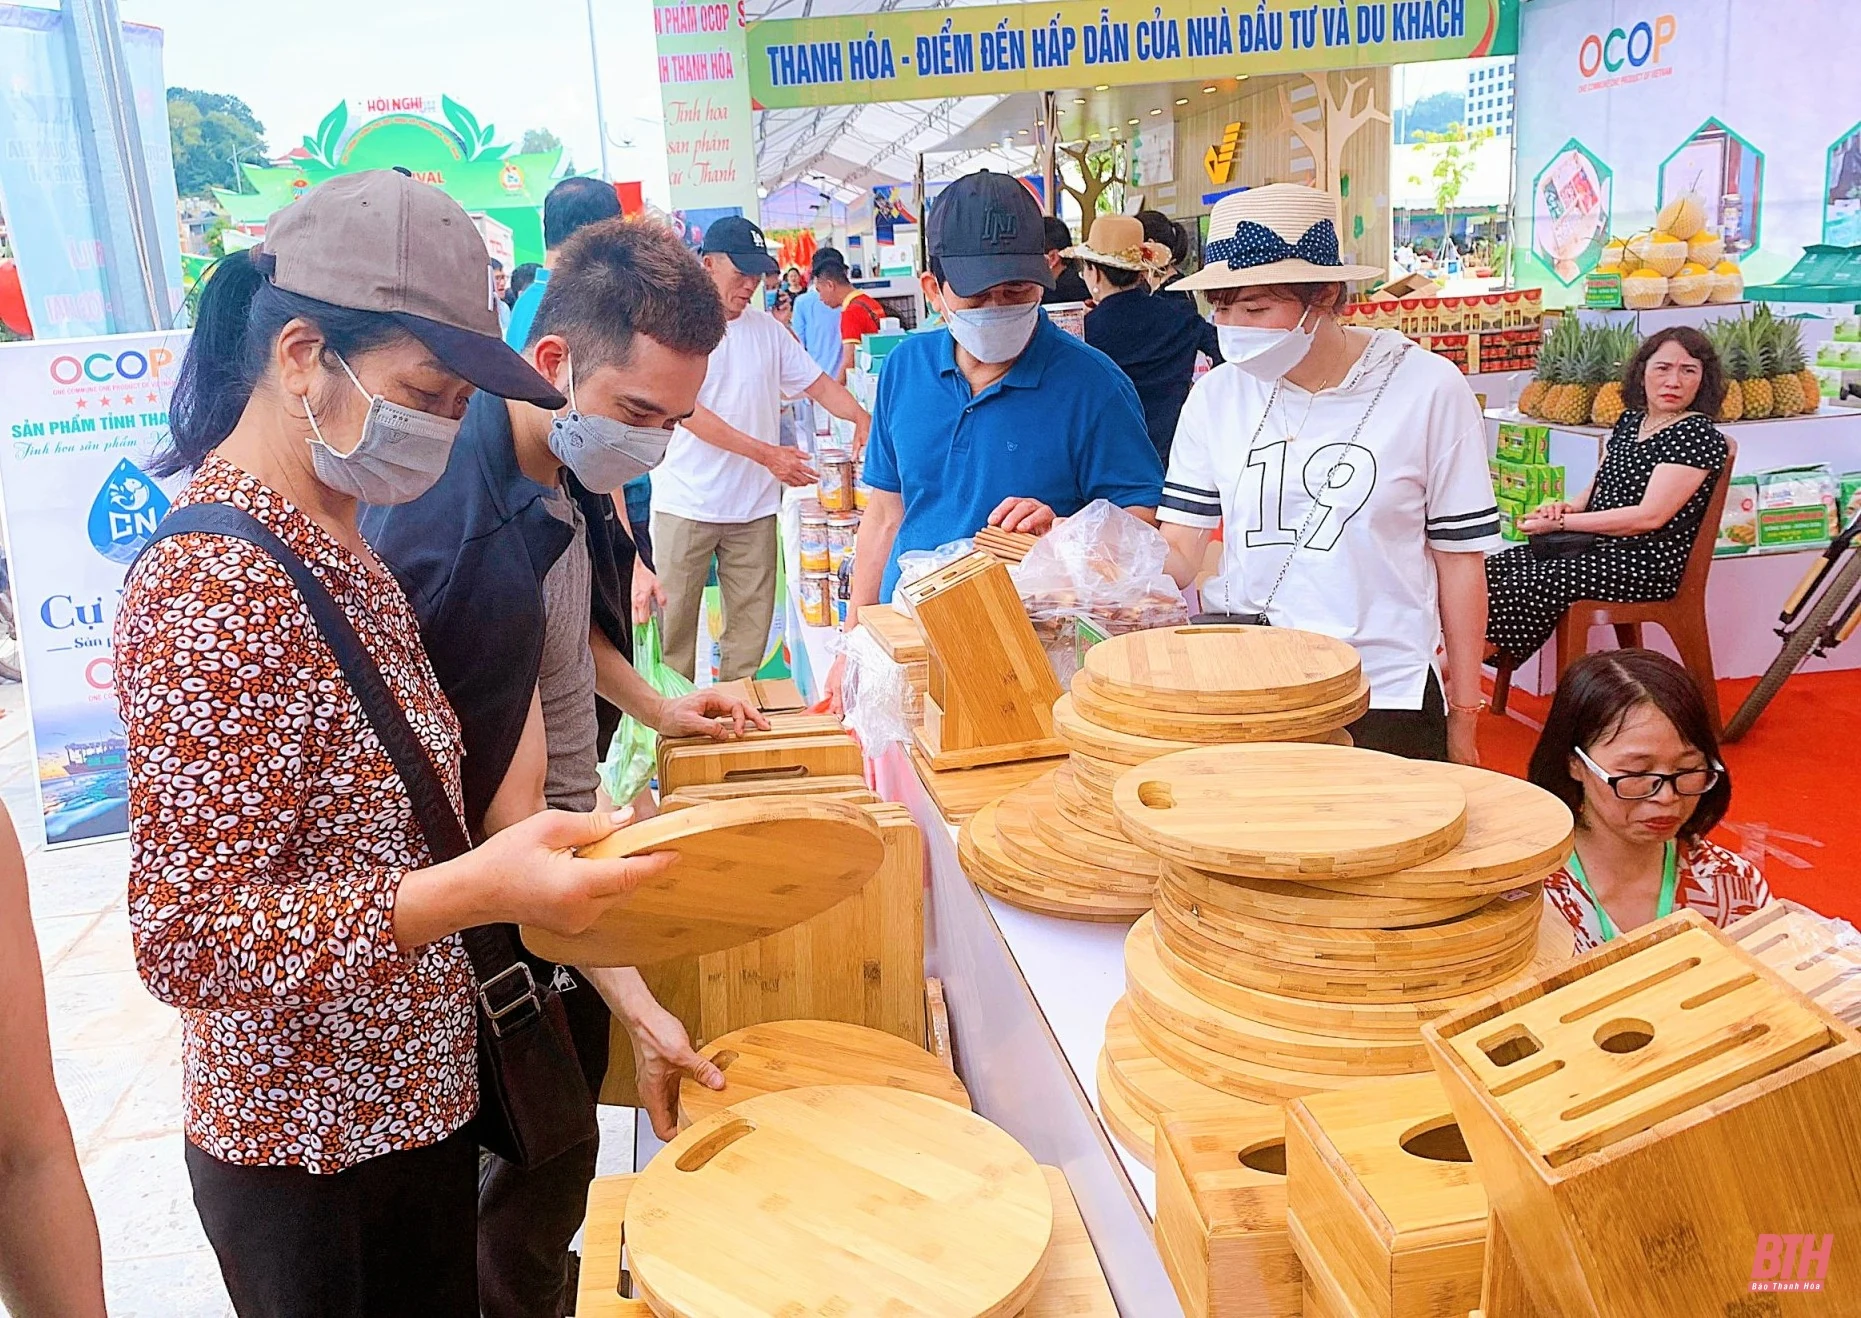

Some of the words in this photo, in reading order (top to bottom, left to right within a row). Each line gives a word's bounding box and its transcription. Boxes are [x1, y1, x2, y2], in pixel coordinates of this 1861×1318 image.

[701, 4, 729, 32] OCOP
[767, 42, 843, 86] THANH
[849, 31, 896, 81] HÓA
[916, 18, 974, 76] ĐIỂM
[980, 18, 1025, 72] ĐẾN
[1032, 12, 1076, 68] HẤP
[1083, 8, 1129, 65] DẪN
[1136, 7, 1181, 60] CỦA
[1187, 7, 1233, 57] NHÀ
[1239, 0, 1283, 53] ĐẦU
[1289, 5, 1318, 49] TƯ
[1322, 0, 1350, 47] VÀ
[1357, 4, 1385, 44] DU
[1580, 14, 1677, 78] OCOP
[672, 54, 708, 82] THANH
[711, 47, 734, 80] HÓA
[706, 96, 728, 121] hoa
[50, 348, 174, 385] OCOP
[12, 419, 45, 439] SẢN
[50, 414, 96, 435] PHẨM
[100, 412, 136, 431] TỈNH
[13, 441, 49, 460] Tinh
[1246, 440, 1377, 552] 19
